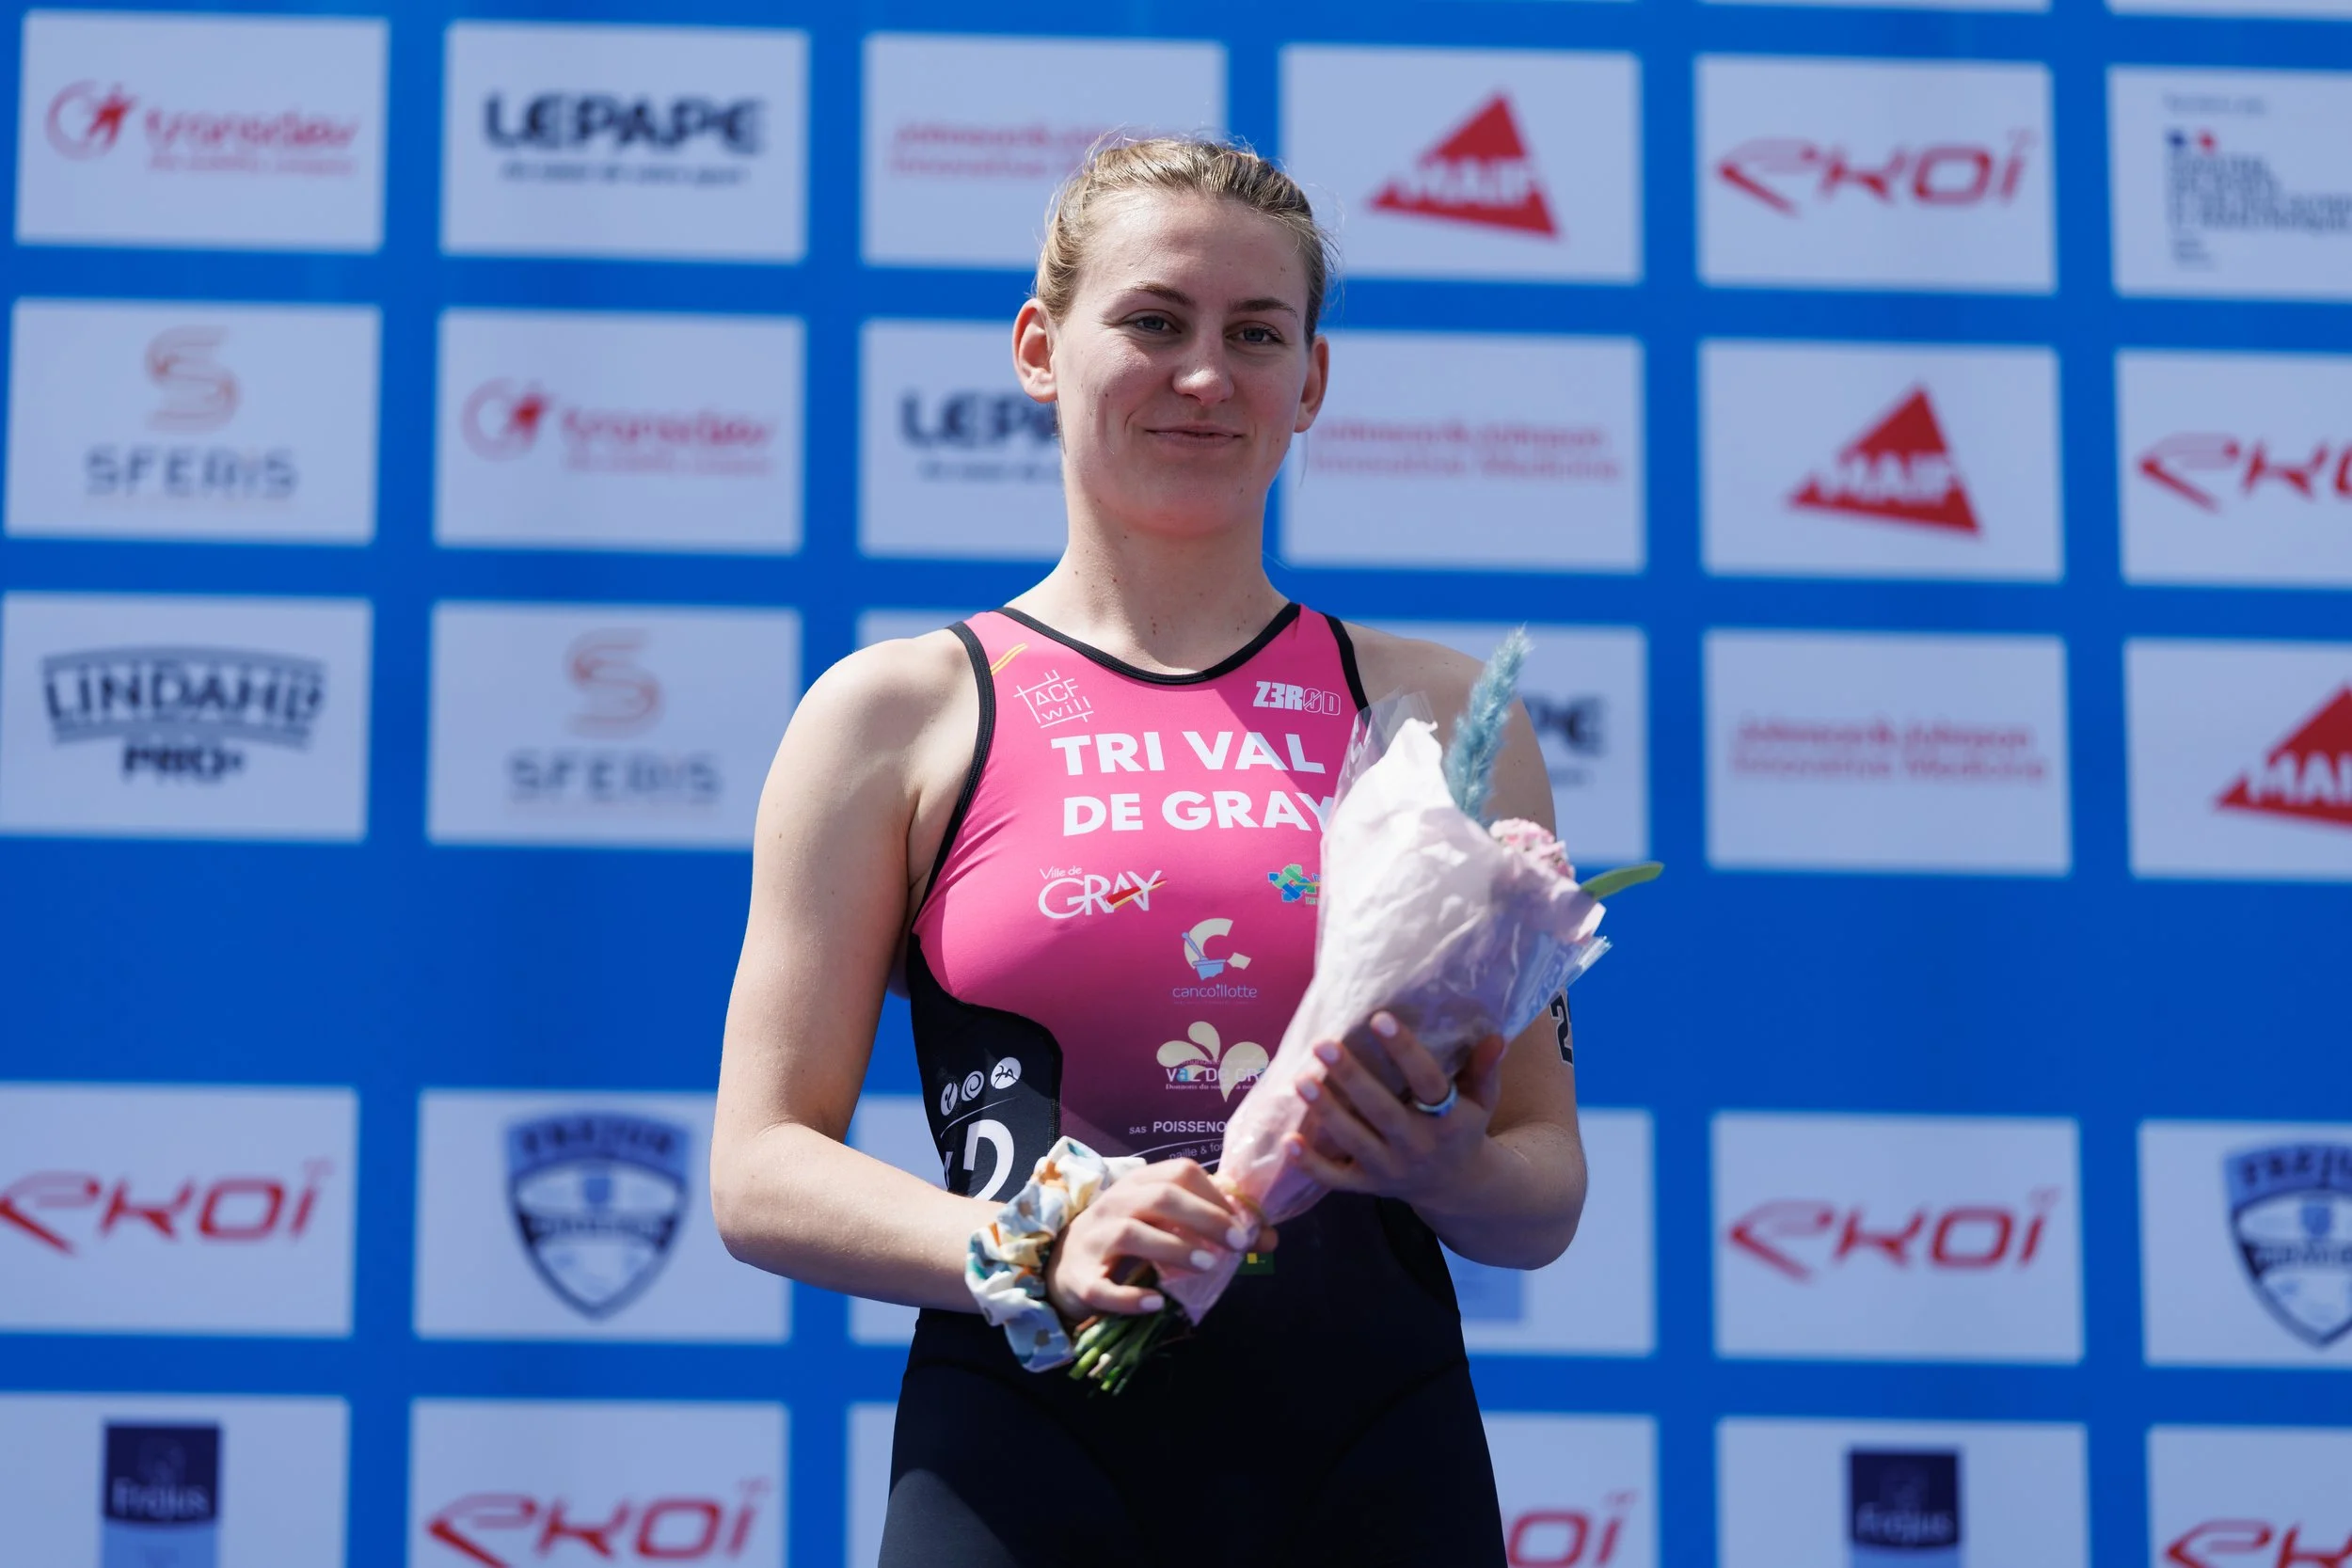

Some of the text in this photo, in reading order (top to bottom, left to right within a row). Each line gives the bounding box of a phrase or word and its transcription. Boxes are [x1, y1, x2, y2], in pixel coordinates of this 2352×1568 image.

[484, 95, 765, 154] LEPAPE
[1394, 154, 1535, 210] MAIF
[85, 445, 299, 502] SFERIS
[1818, 451, 1959, 508] MAIF
[506, 752, 723, 807] SFERIS
[1051, 731, 1326, 776] TRI VAL
[2246, 750, 2352, 807] MAI
[1063, 790, 1334, 836] DE GRAY
[1038, 869, 1163, 920] GRAY
[1039, 864, 1083, 880] Ville de
[1129, 1120, 1228, 1135] SAS POISSENO
[1200, 1145, 1208, 1155] &
